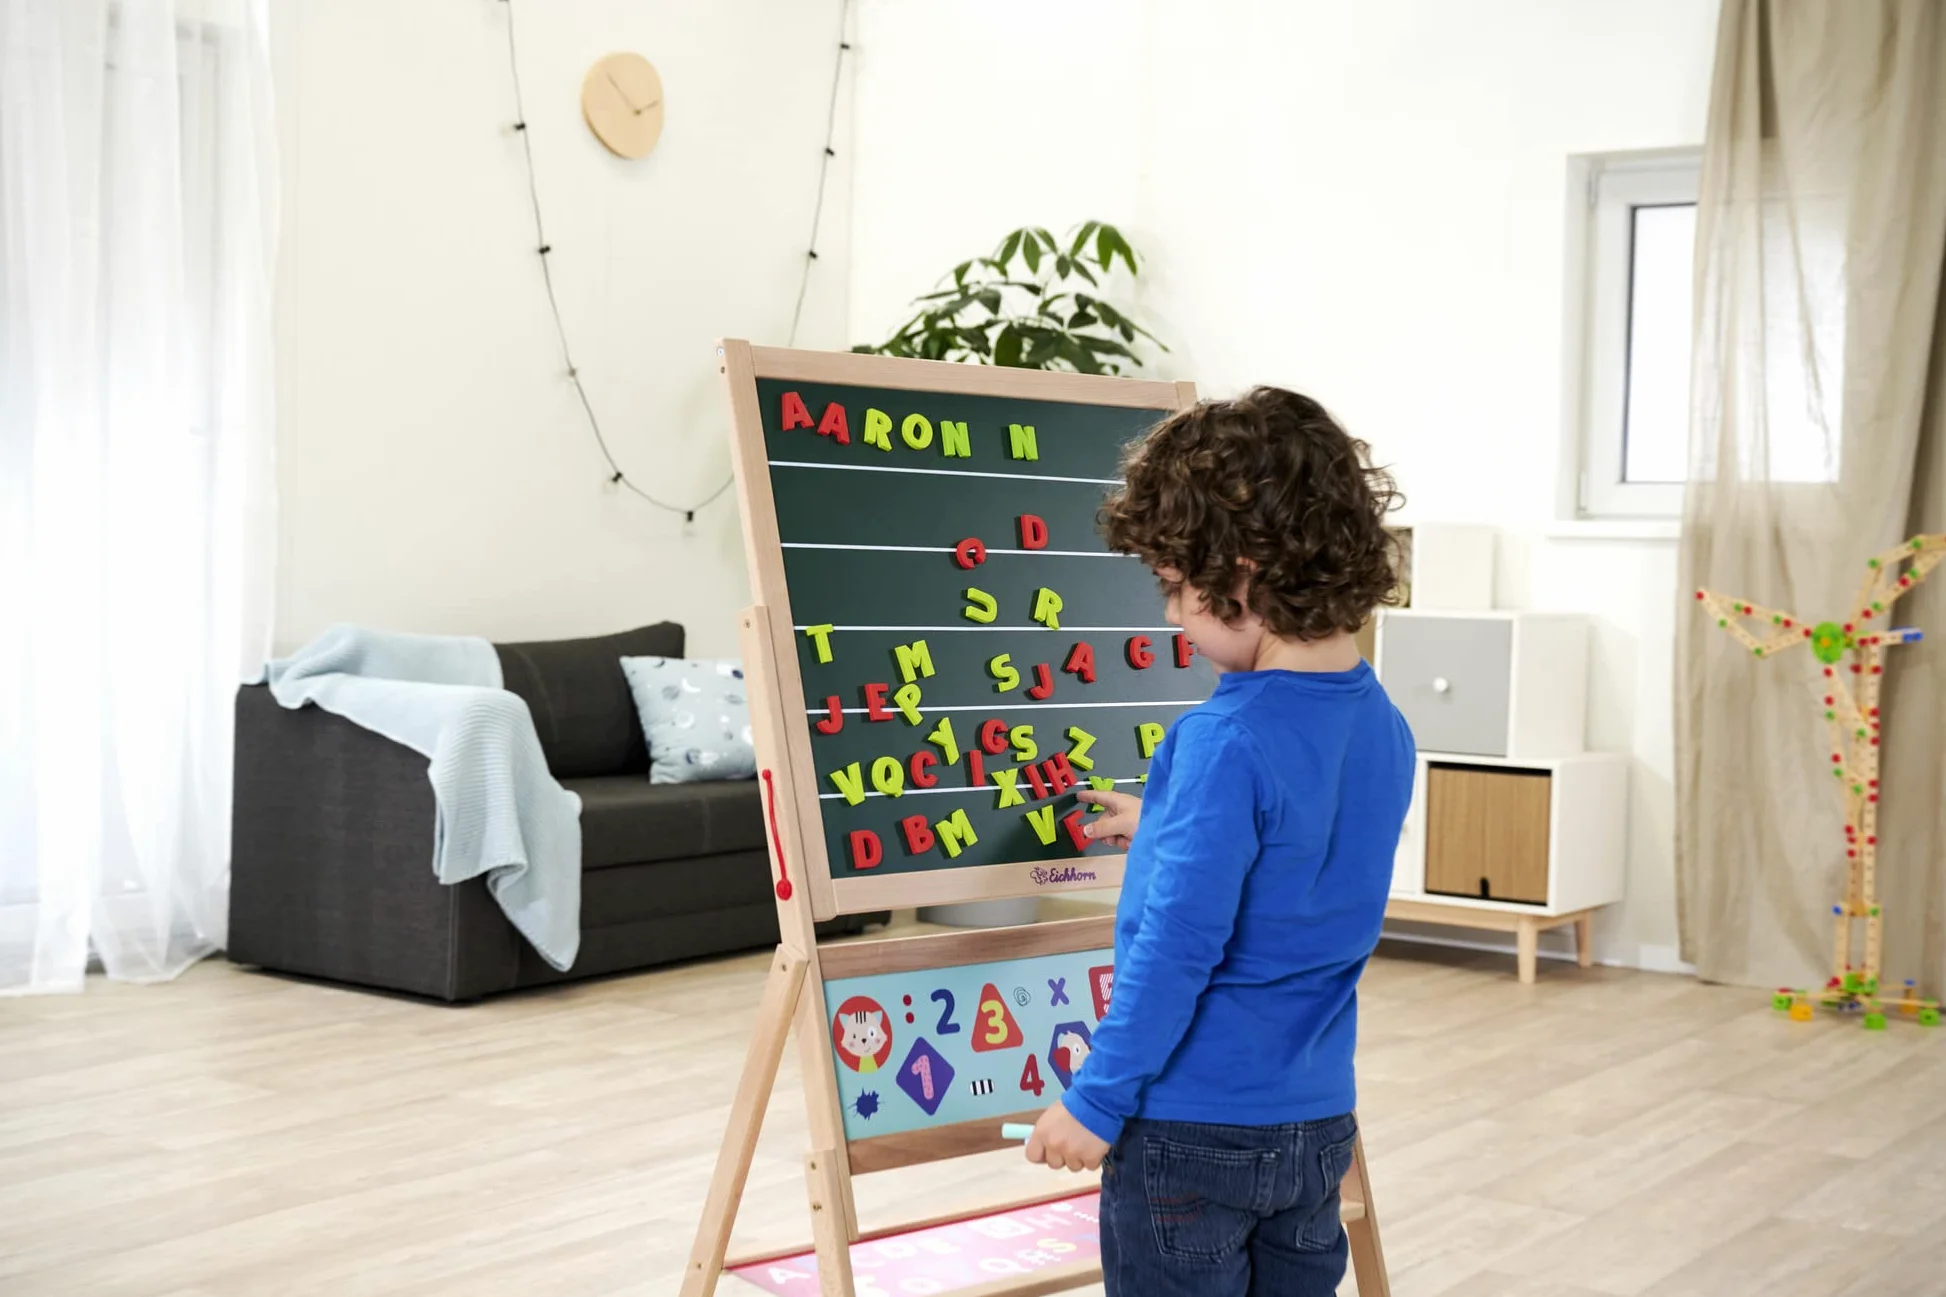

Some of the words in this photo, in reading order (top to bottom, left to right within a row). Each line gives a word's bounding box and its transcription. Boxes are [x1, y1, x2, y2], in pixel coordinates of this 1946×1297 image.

[782, 391, 972, 458] AARON
[1008, 423, 1040, 463] N
[1020, 514, 1049, 550] D
[1033, 587, 1064, 631] R
[805, 623, 835, 665] T
[893, 639, 936, 684] M
[1066, 641, 1097, 684] A
[990, 653, 1021, 693] S
[1029, 663, 1055, 700] J
[816, 695, 844, 734] J
[864, 682, 895, 722] E
[893, 683, 924, 727] P
[927, 717, 960, 766] Y
[1009, 725, 1039, 762] S
[1066, 725, 1098, 772] Z
[1139, 722, 1165, 758] P
[829, 761, 866, 807] V
[871, 755, 905, 798] Q
[910, 750, 939, 788] C
[990, 767, 1026, 809] X
[902, 815, 935, 855] B
[935, 808, 979, 859] M
[1025, 804, 1057, 846] V
[849, 829, 884, 870] D
[1048, 867, 1097, 883] Eichhorn
[930, 988, 961, 1036] 2
[980, 999, 1009, 1045] 3
[910, 1053, 934, 1100] 1
[1019, 1053, 1045, 1097] 4
